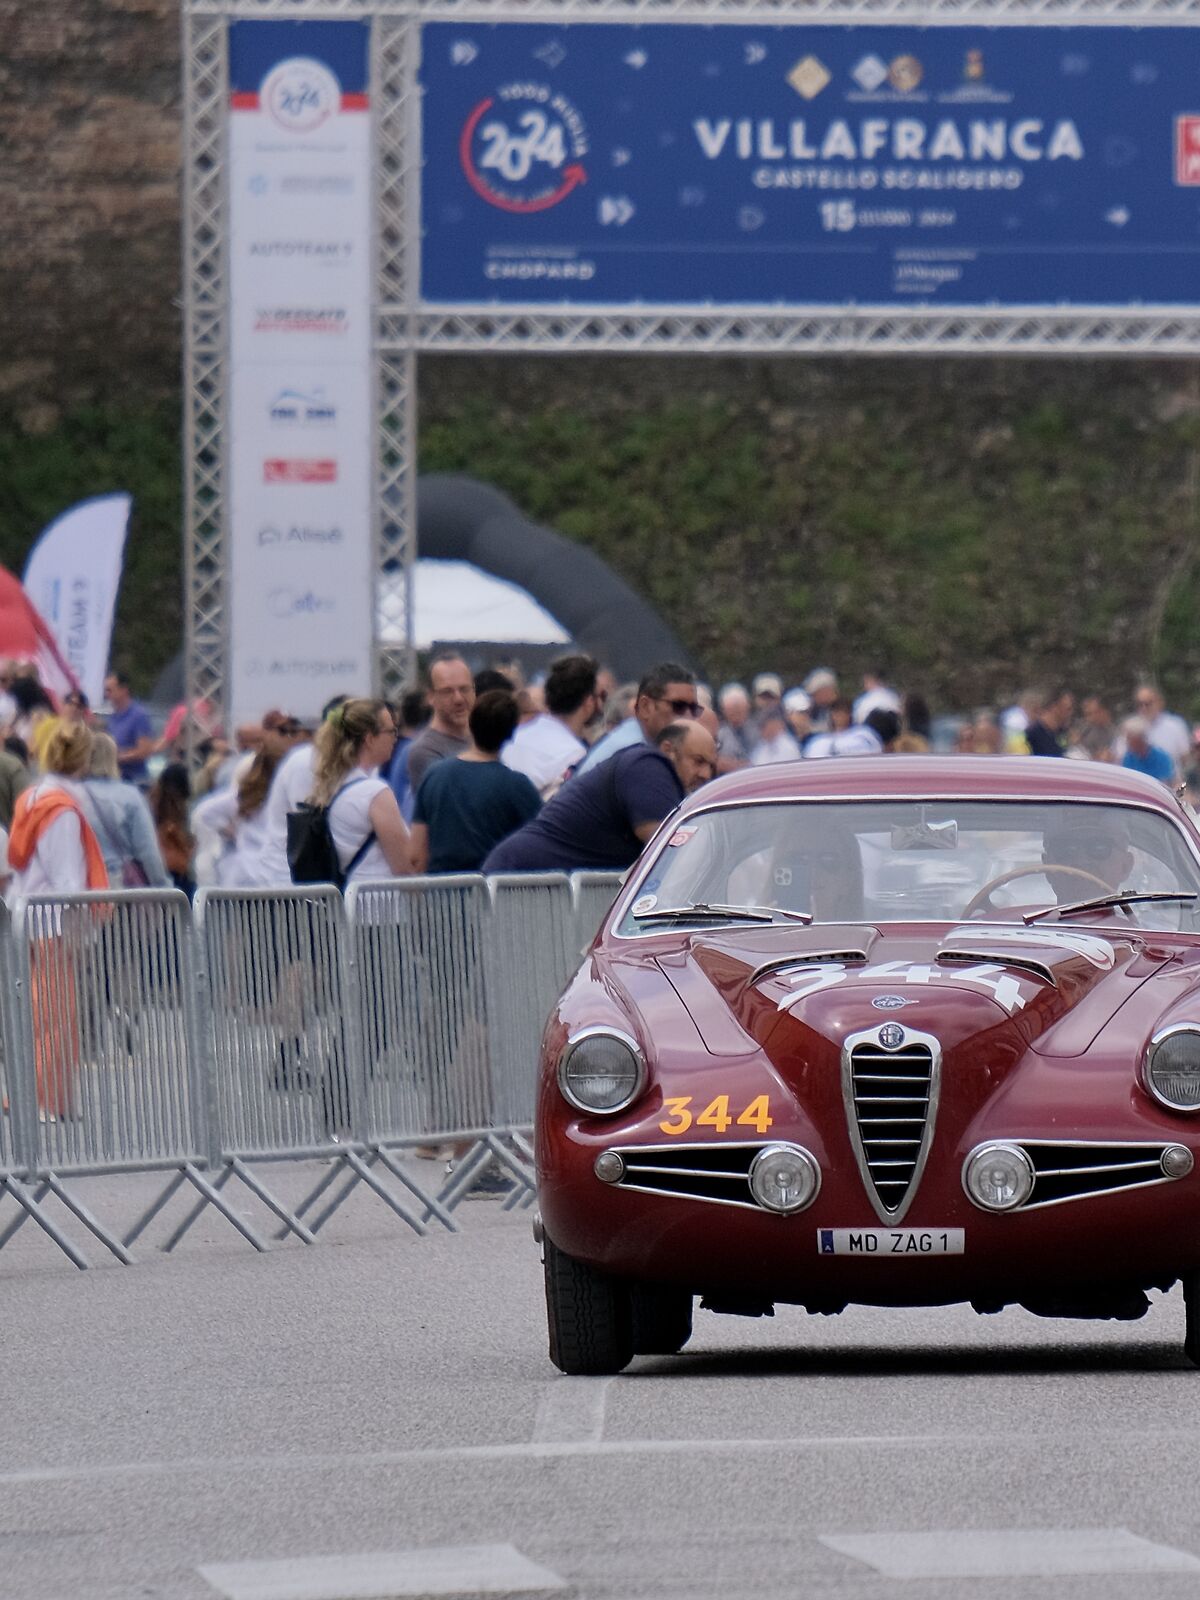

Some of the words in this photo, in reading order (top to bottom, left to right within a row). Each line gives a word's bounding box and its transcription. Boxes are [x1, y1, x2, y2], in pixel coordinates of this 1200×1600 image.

[480, 111, 567, 181] 2024
[694, 118, 1084, 160] VILLAFRANCA
[752, 167, 878, 190] CASTELLO
[881, 167, 1024, 190] SCALIGERO
[821, 200, 855, 232] 15
[486, 260, 595, 280] CHOPARD
[775, 960, 1028, 1012] 344
[658, 1094, 773, 1136] 344
[849, 1233, 878, 1252] MD
[890, 1233, 932, 1253] ZAG
[940, 1233, 948, 1252] 1
